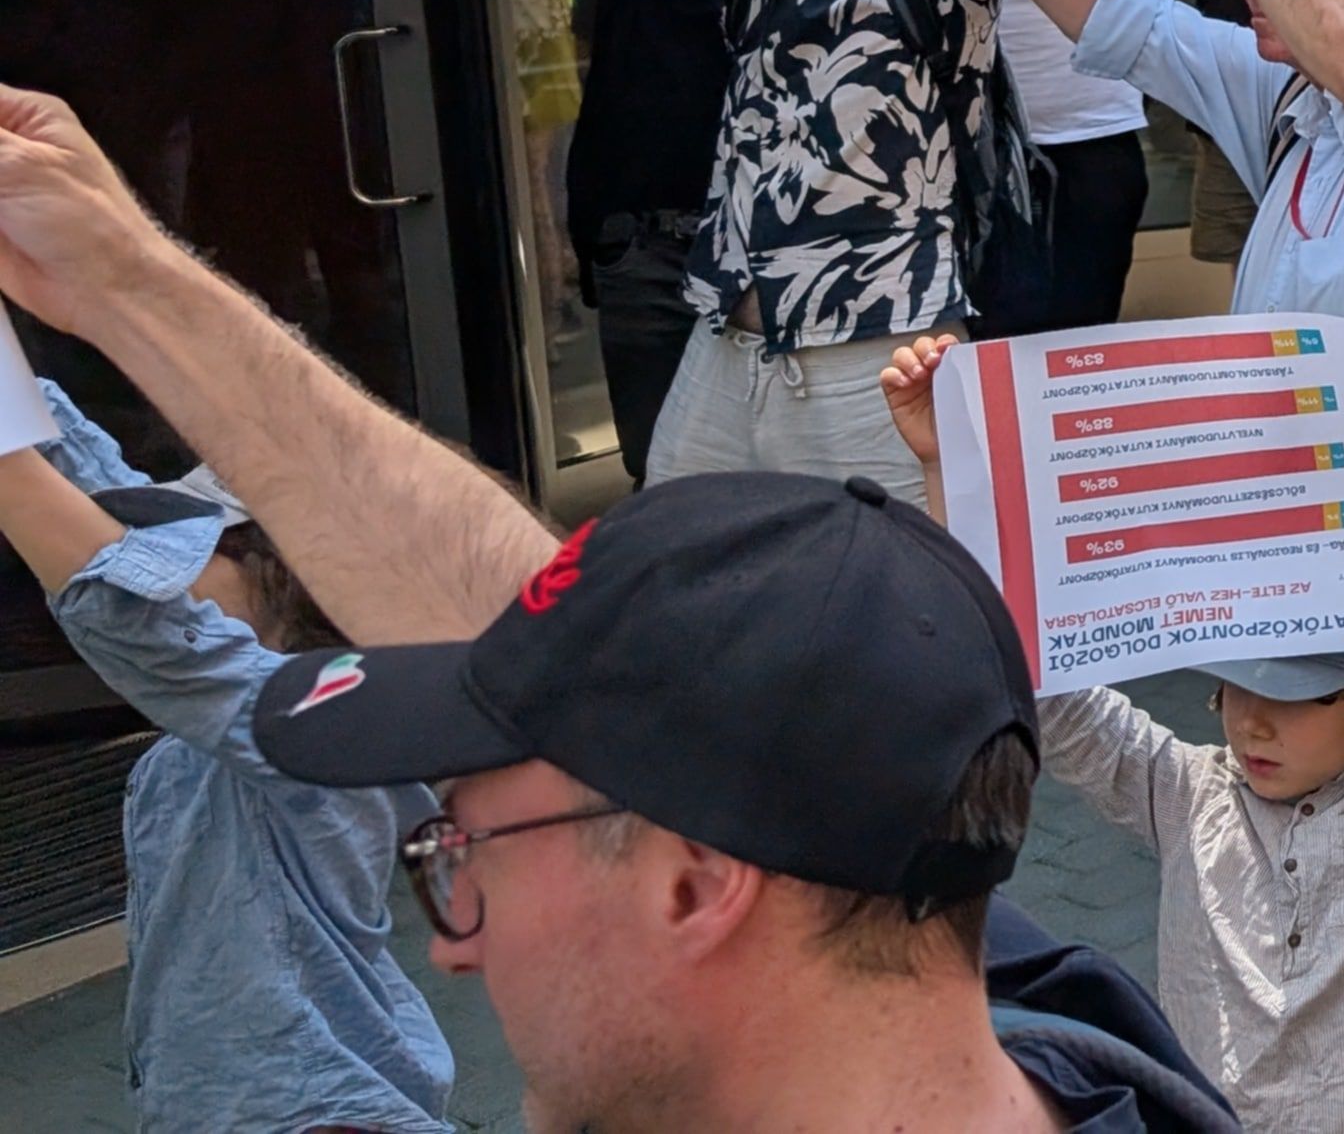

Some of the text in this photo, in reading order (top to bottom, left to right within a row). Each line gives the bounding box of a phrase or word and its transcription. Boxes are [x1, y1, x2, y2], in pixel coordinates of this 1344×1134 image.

[1066, 352, 1104, 368] 83%
[1042, 367, 1294, 399] TÁRSADALOMTUDOMÁNYI KUTATÓKÖZPONT
[1075, 417, 1113, 432] 88%
[1049, 428, 1263, 462] NYELVTUDOMÁNYI KUTATÓKÖZPONT
[1080, 477, 1118, 492] 92%
[1056, 502, 1159, 525] KUTATÓKÖZPONT
[1086, 539, 1125, 555] 93%
[1230, 542, 1303, 559] REGIONÁLIS
[1155, 552, 1228, 568] TUDOMÁNYI
[1059, 563, 1152, 585] KUTATÓKÖZPONT
[1290, 581, 1312, 594] AZ
[1166, 591, 1206, 607] VALÓ
[1045, 598, 1160, 628] ELCSATOLÁSRA
[1049, 607, 1233, 651] NEMET MONDTAK
[1049, 636, 1160, 672] DOLGOZÓI
